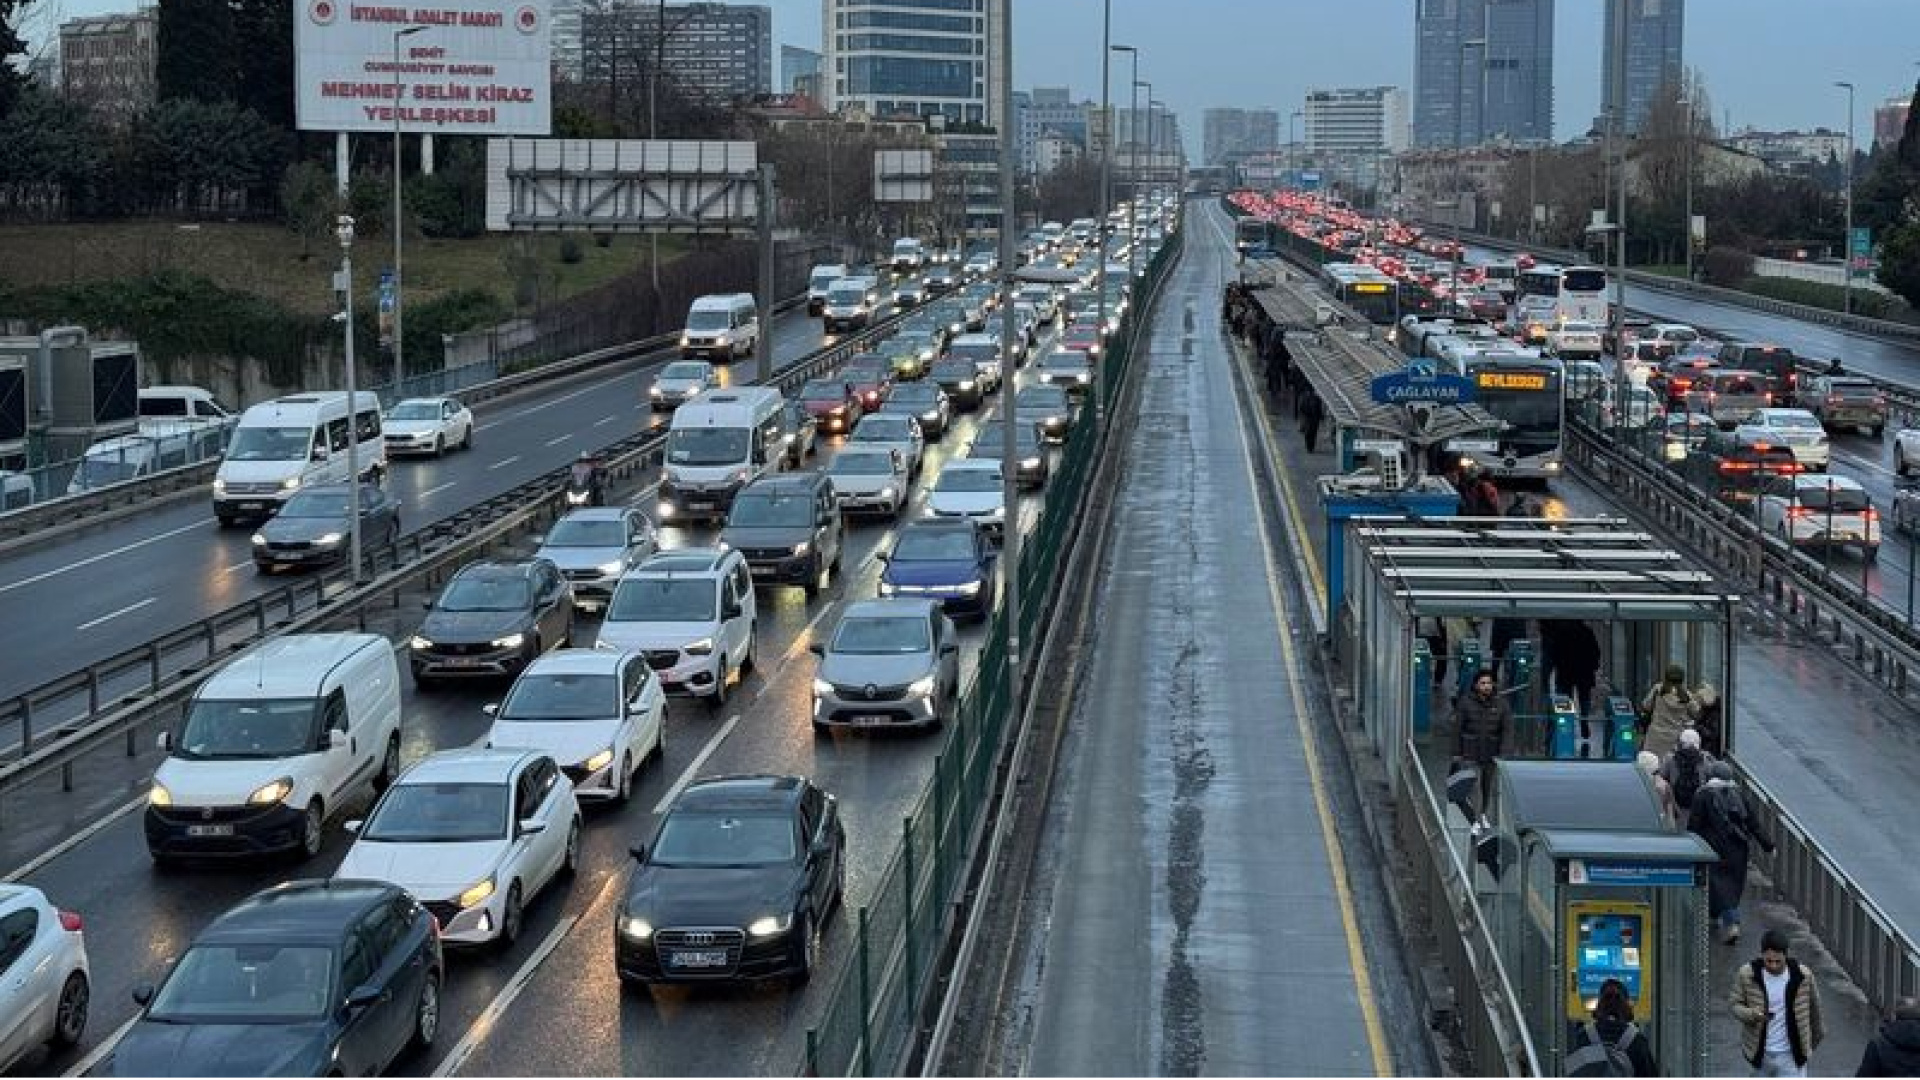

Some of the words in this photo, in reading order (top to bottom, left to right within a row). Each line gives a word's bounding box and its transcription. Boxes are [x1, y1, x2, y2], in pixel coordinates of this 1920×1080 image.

[321, 81, 406, 99] MEHMET
[413, 82, 471, 101] SELİM
[476, 83, 534, 103] KİRAZ
[363, 105, 496, 125] YERLEŞKESİ
[1387, 384, 1459, 400] ÇAĞLAYAN
